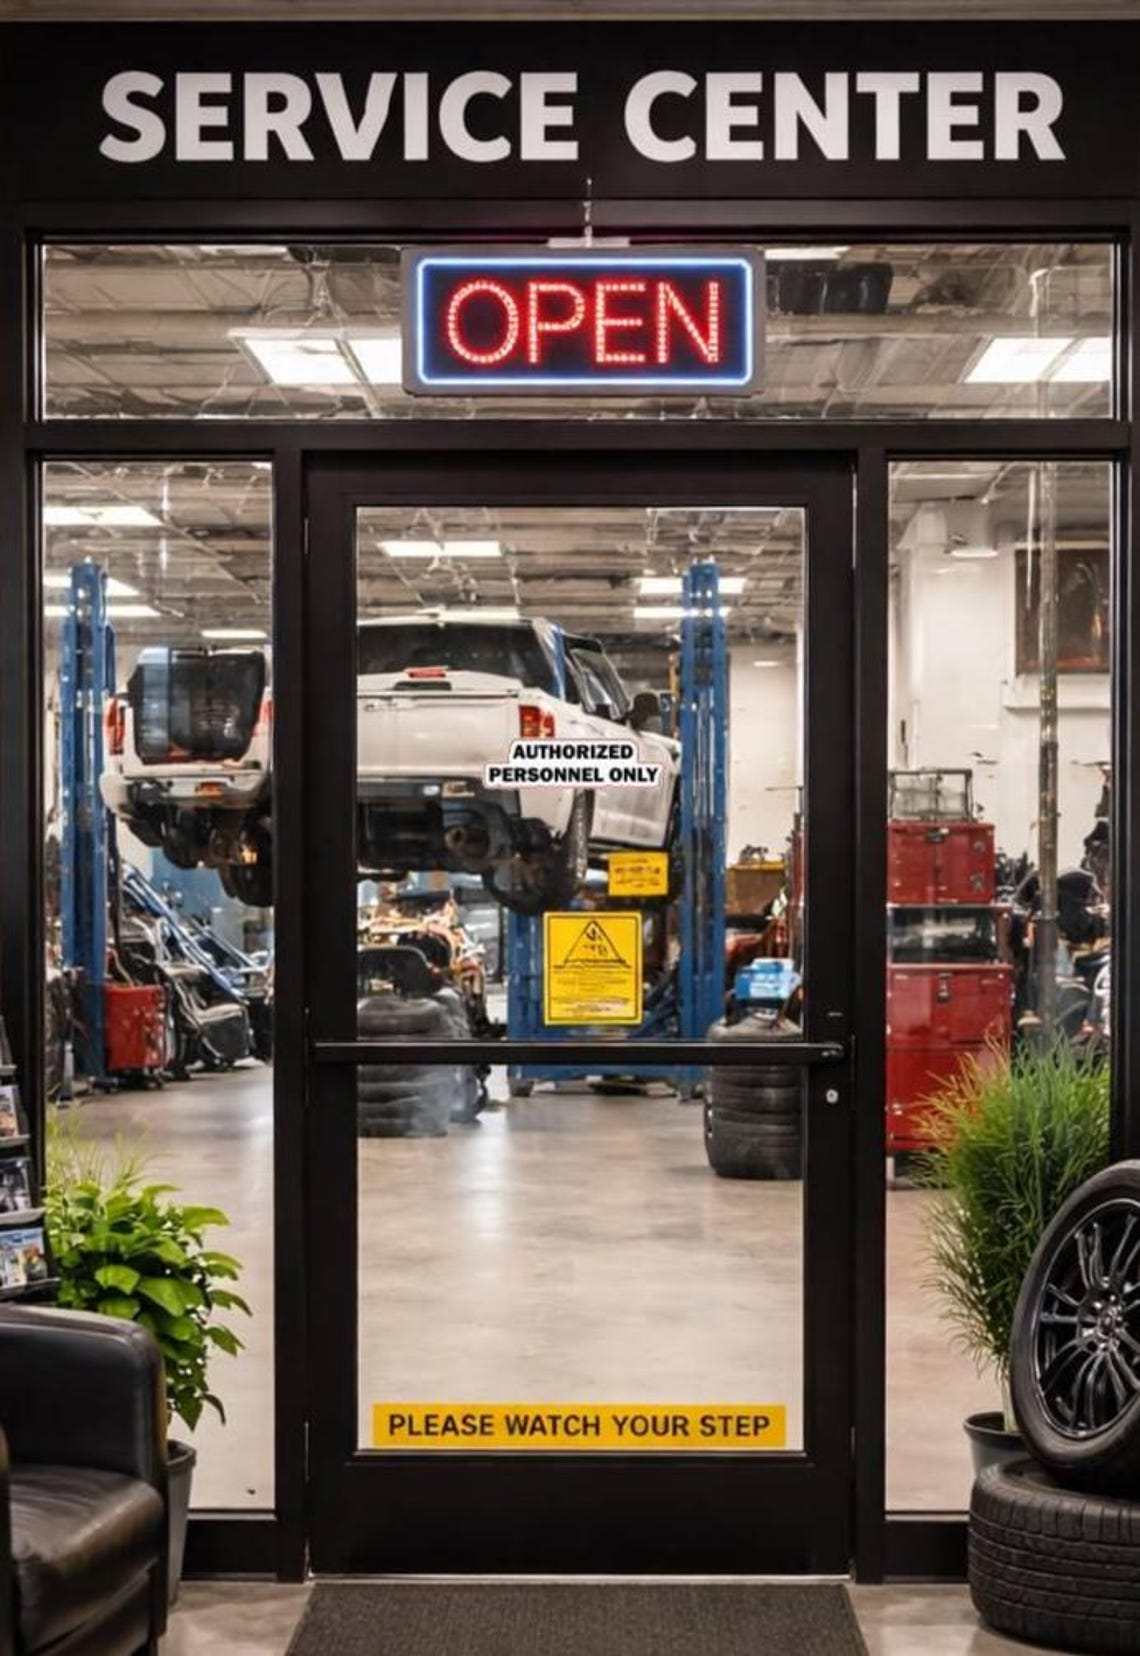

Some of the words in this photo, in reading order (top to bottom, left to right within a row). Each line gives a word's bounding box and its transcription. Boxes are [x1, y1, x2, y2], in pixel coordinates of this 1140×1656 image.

[99, 70, 579, 163] SERVICE
[624, 70, 1066, 163] CENTER
[444, 278, 722, 368] OPEN
[512, 744, 634, 760] AUTHORIZED
[488, 767, 604, 783] PERSONNEL
[608, 767, 660, 783] ONLY
[388, 1413, 494, 1437] PLEASE
[505, 1413, 600, 1437] WATCH
[612, 1414, 689, 1437] YOUR
[700, 1414, 770, 1437] STEP
